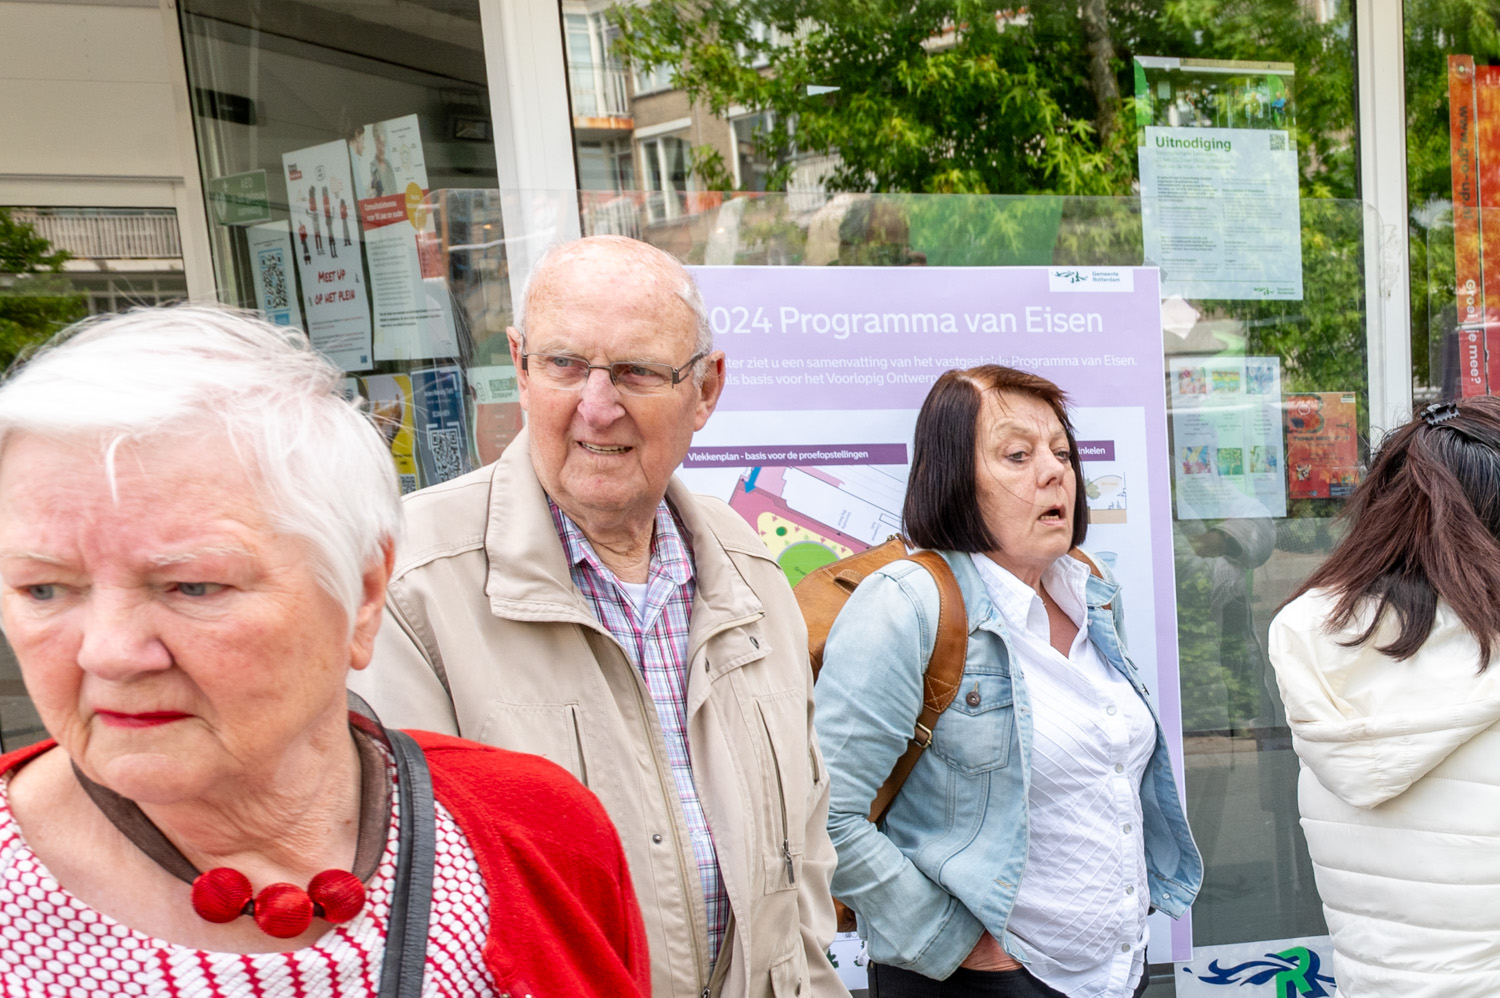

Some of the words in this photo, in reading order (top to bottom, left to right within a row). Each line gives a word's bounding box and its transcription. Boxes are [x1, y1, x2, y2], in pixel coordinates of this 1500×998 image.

[1155, 136, 1232, 152] Uitnodiging
[1458, 105, 1474, 220] www.gro-up.nl
[710, 306, 772, 334] 024
[779, 305, 959, 340] Programma
[964, 313, 1017, 333] van
[1025, 306, 1103, 333] Eisen
[747, 357, 769, 369] ziet
[771, 359, 780, 368] u
[782, 359, 804, 368] een
[806, 356, 887, 371] samenvatting
[890, 358, 911, 368] van
[914, 356, 933, 368] het
[1012, 355, 1079, 370] Programma
[1082, 357, 1102, 367] van
[1104, 355, 1138, 367] Eisen.
[1467, 343, 1482, 385] mee?
[741, 373, 774, 385] basis
[775, 375, 803, 385] voor
[805, 373, 824, 384] het
[826, 372, 884, 387] Voorlopig
[887, 372, 938, 386] Ontwerp
[688, 452, 740, 463] Vlekkenplan
[745, 451, 767, 461] basis
[768, 452, 785, 460] voor
[786, 450, 798, 460] de
[799, 450, 869, 462] proefopstellingen
[1079, 446, 1106, 455] inkelen
